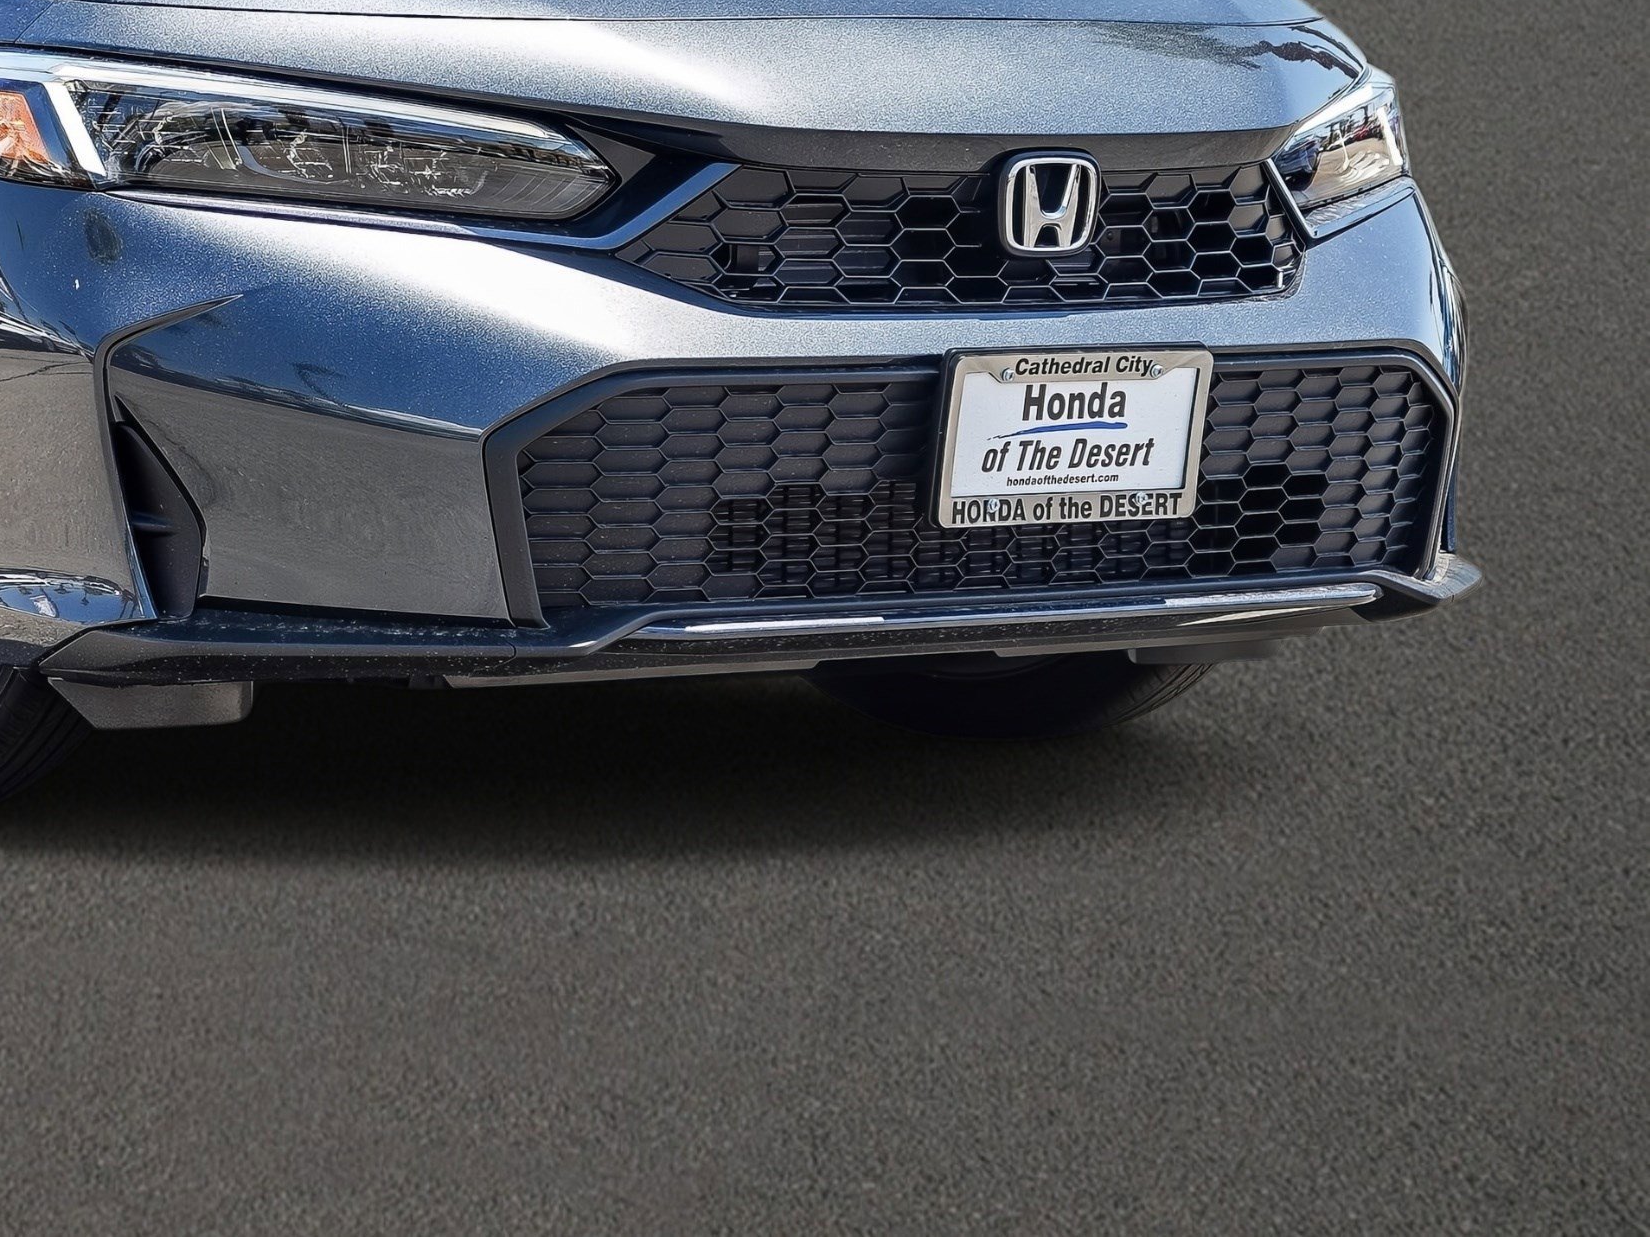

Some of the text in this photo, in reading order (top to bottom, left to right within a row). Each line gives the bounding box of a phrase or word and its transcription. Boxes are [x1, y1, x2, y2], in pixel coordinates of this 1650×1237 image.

[1014, 355, 1154, 378] Cathedral City
[1021, 381, 1127, 422] Honda
[981, 437, 1156, 473] of The Desert
[1006, 473, 1119, 487] hondaofthedesert.com
[951, 492, 1183, 525] HONDA of the DESERT
